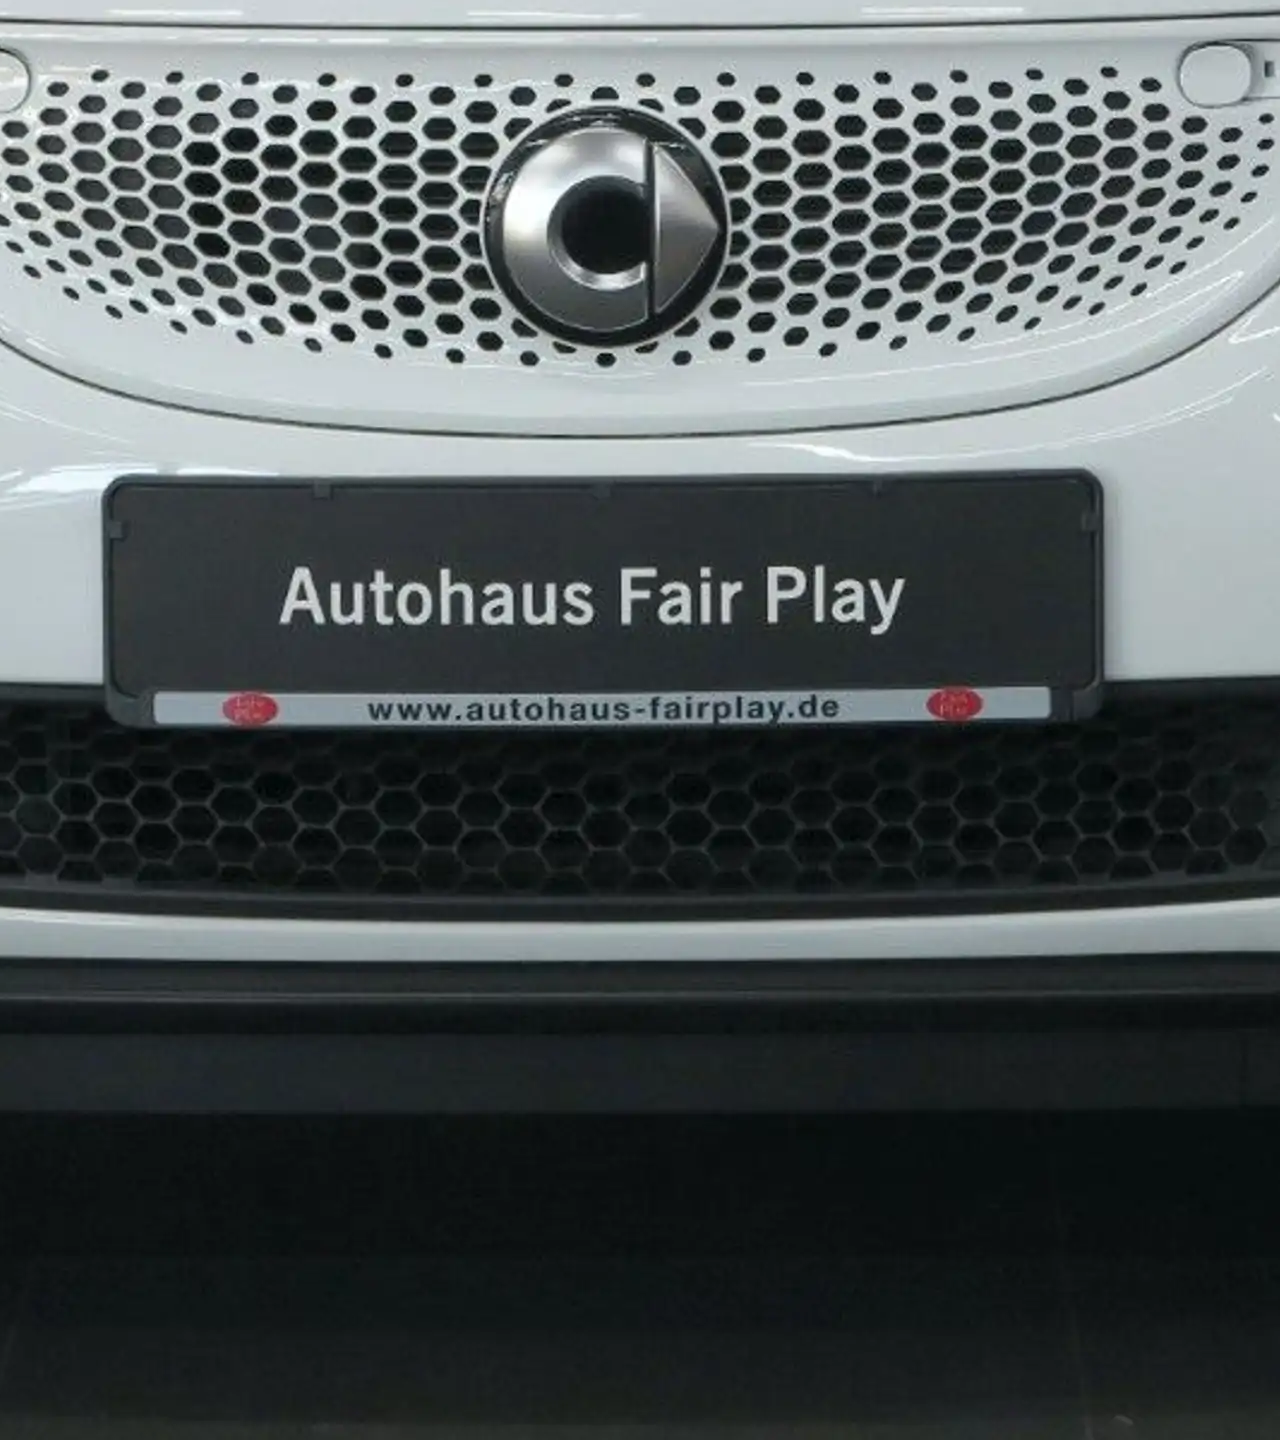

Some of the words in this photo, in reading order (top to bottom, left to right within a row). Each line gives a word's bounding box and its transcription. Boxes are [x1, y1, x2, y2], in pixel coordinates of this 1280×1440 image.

[279, 566, 594, 626] Autohaus
[620, 566, 743, 625] Fair
[766, 564, 905, 635] Play
[367, 694, 841, 724] www.autohaus-fairplay.de
